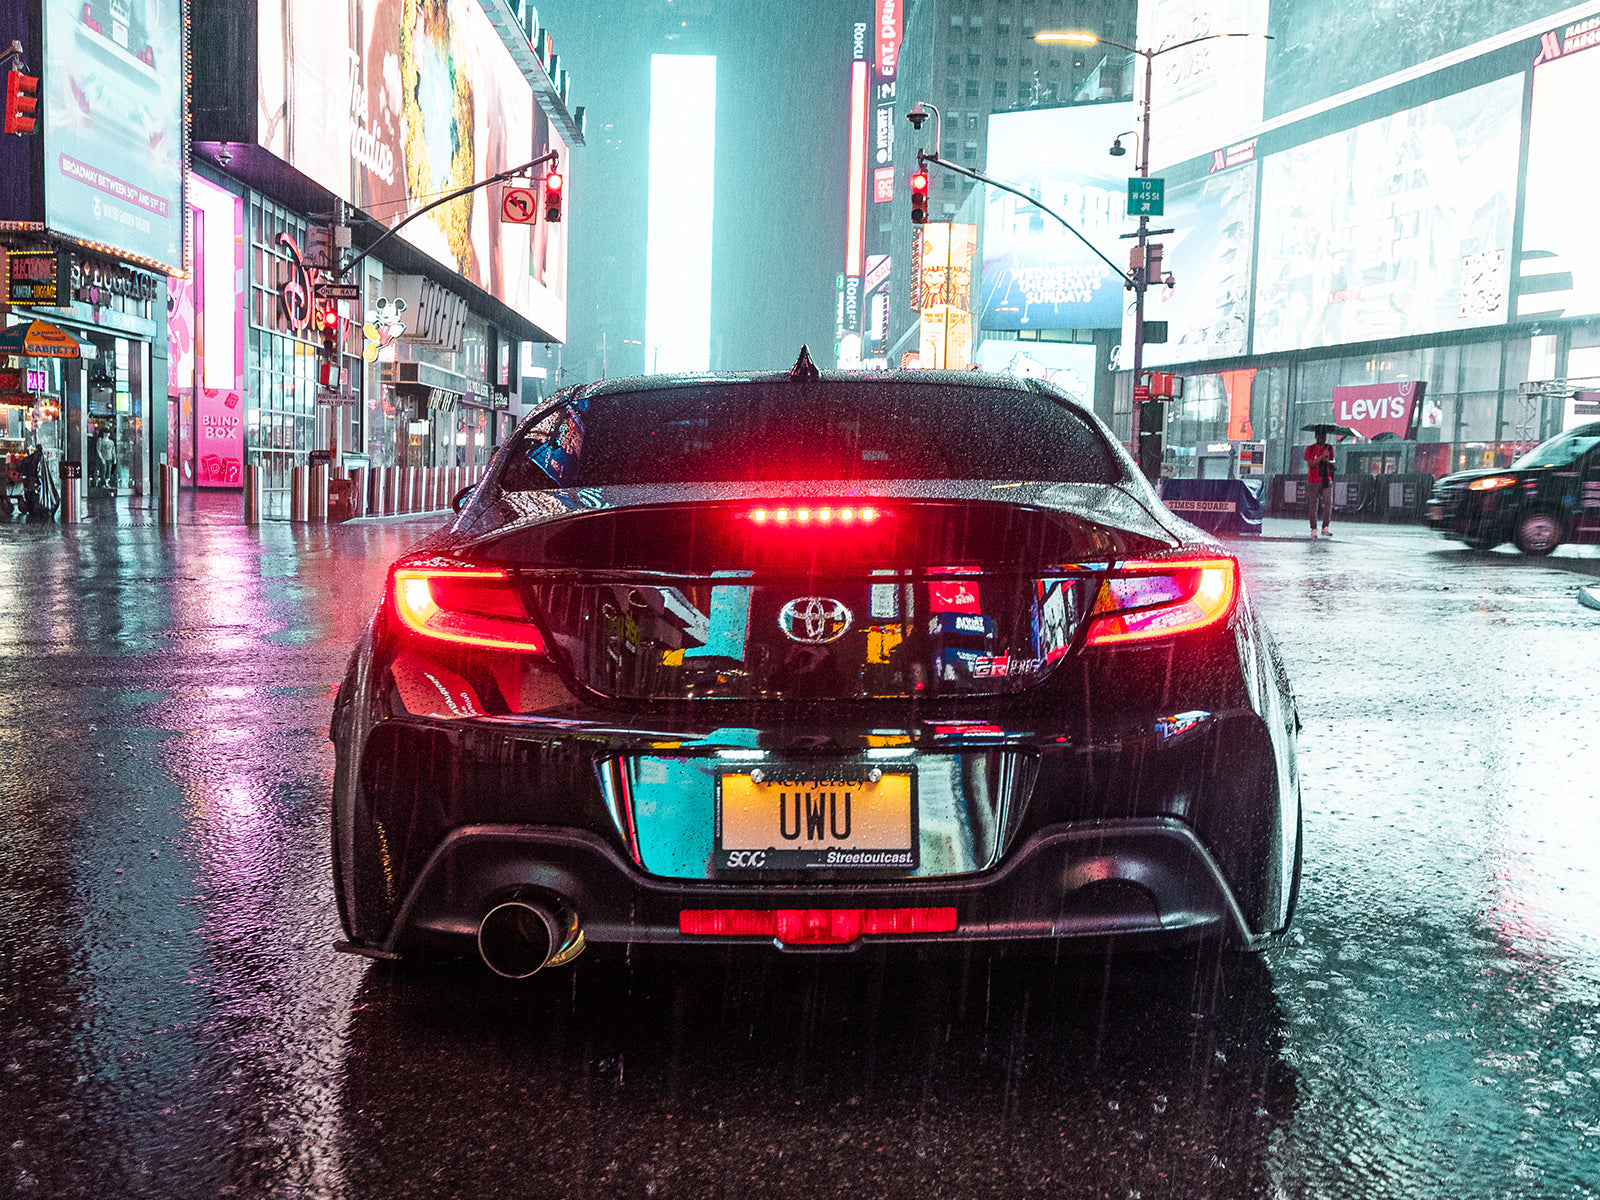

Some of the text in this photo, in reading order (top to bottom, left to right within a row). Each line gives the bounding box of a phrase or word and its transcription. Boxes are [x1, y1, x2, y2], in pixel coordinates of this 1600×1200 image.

[62, 158, 98, 184] BROADWAY
[98, 174, 127, 196] BETWEEN
[138, 193, 150, 207] AND
[1141, 181, 1152, 189] TO
[1132, 191, 1160, 200] W 45 St
[1010, 265, 1110, 281] WEDNESDAYS
[1017, 277, 1103, 292] THURSDAYS
[340, 288, 355, 296] WAY
[1025, 290, 1092, 304] SUNDAYS
[27, 344, 77, 355] SABRETT
[203, 415, 240, 426] BLIND
[206, 426, 237, 439] BOX
[1169, 501, 1229, 511] TIMES SQUARE
[779, 792, 851, 841] UWU
[826, 851, 914, 863] Streetoutcast.
